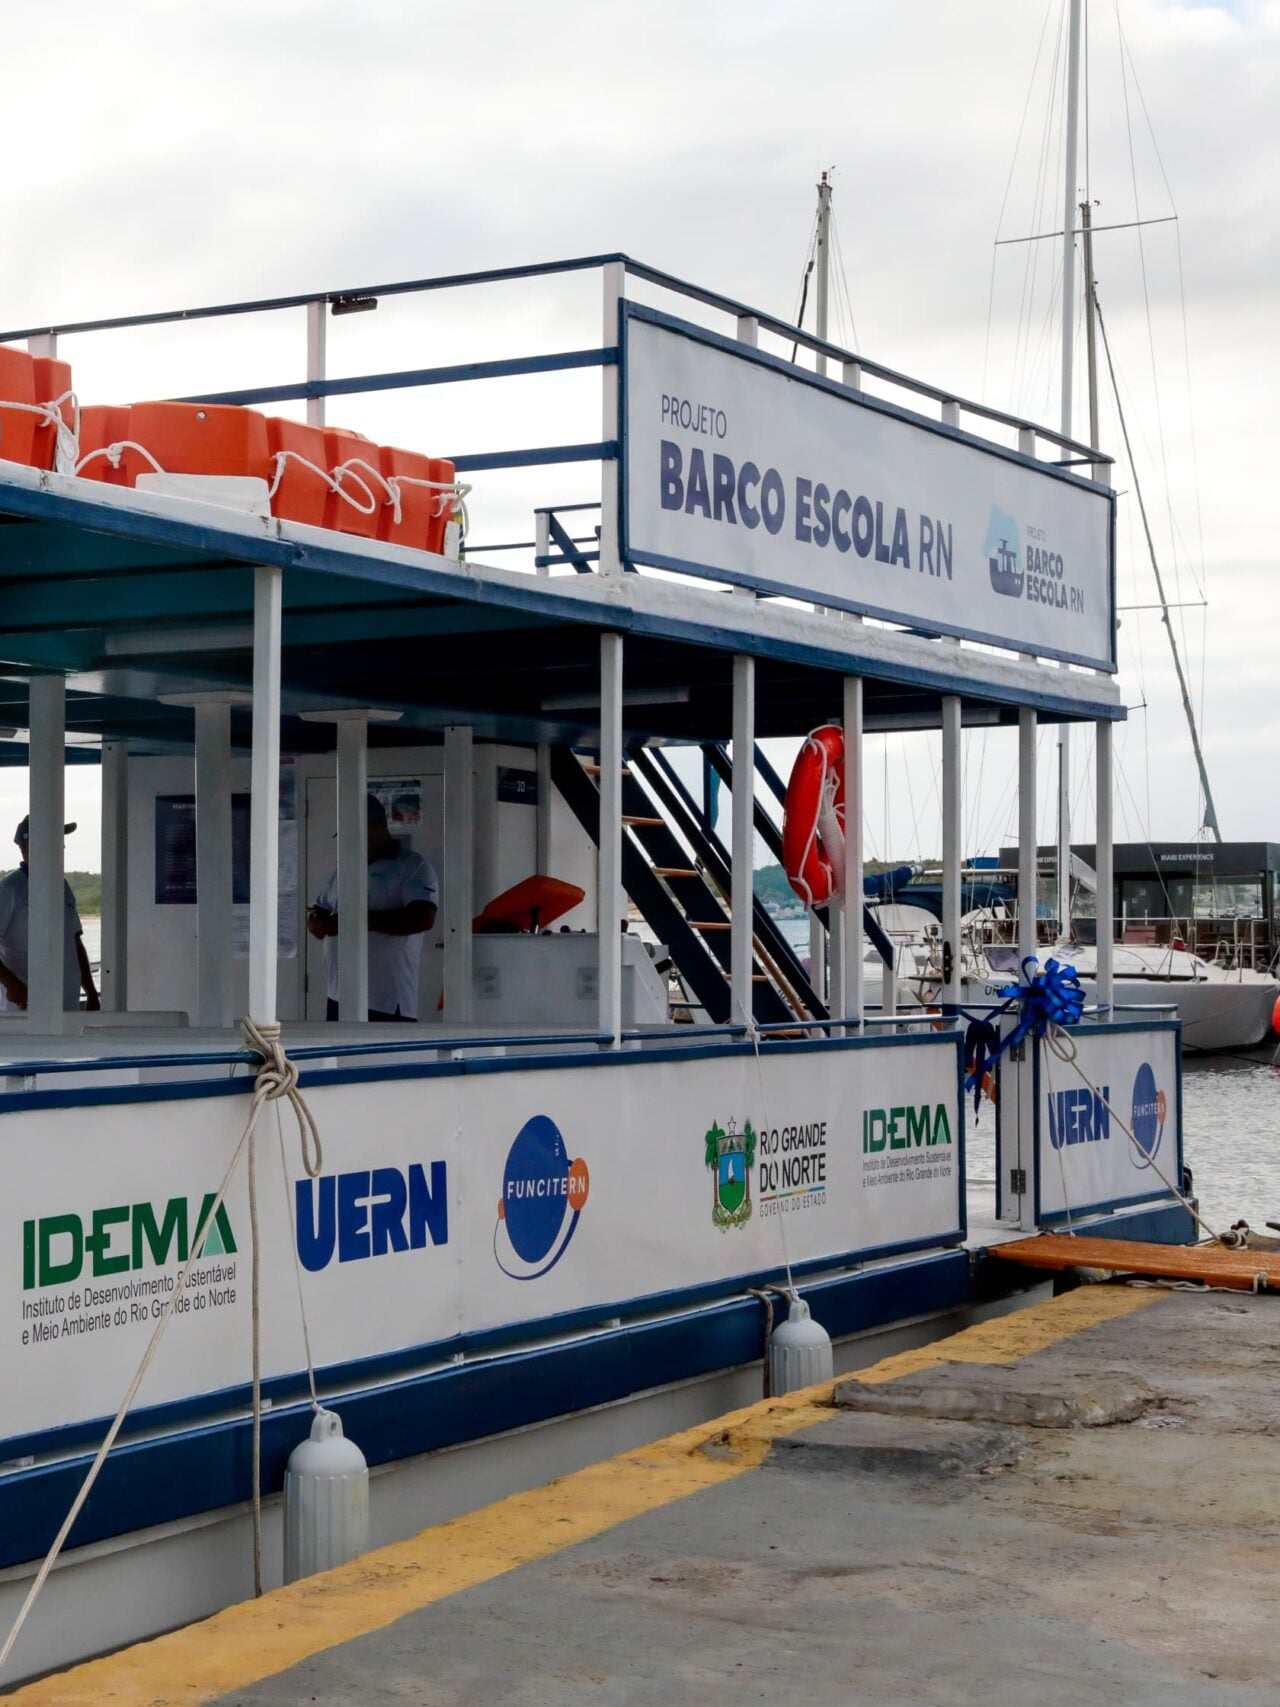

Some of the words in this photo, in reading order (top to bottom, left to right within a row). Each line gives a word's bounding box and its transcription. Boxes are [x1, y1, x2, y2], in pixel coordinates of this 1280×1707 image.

[661, 394, 727, 440] PROJETO
[660, 440, 785, 535] BARCO
[795, 477, 910, 569] ESCOLA
[920, 513, 953, 581] RN
[1026, 544, 1063, 580] BARCO
[1026, 574, 1068, 610] ESCOLA
[1071, 586, 1084, 614] RN
[862, 1103, 952, 1154] IDEMA
[1048, 1086, 1110, 1150] UERN
[1133, 1101, 1165, 1118] FUNCITERN
[760, 1129, 779, 1156] RIO
[781, 1122, 827, 1152] GRANDE
[507, 1175, 586, 1200] FUNCITERN
[760, 1161, 779, 1193] DO
[782, 1152, 826, 1189] NORTE
[295, 1160, 449, 1273] UERN
[791, 1197, 801, 1211] DO
[803, 1193, 826, 1209] ESTADO
[22, 1192, 239, 1291] IDEMA
[22, 1295, 65, 1320] Instituto
[67, 1291, 81, 1311] de
[85, 1276, 174, 1307] Desenvolvimento
[22, 1331, 29, 1346] e
[33, 1321, 59, 1344] Meio
[61, 1308, 111, 1337] Ambiente
[114, 1307, 127, 1327] do
[131, 1302, 148, 1322] Rio
[151, 1293, 190, 1317] Grde
[193, 1291, 206, 1311] do
[209, 1287, 237, 1307] Norte
